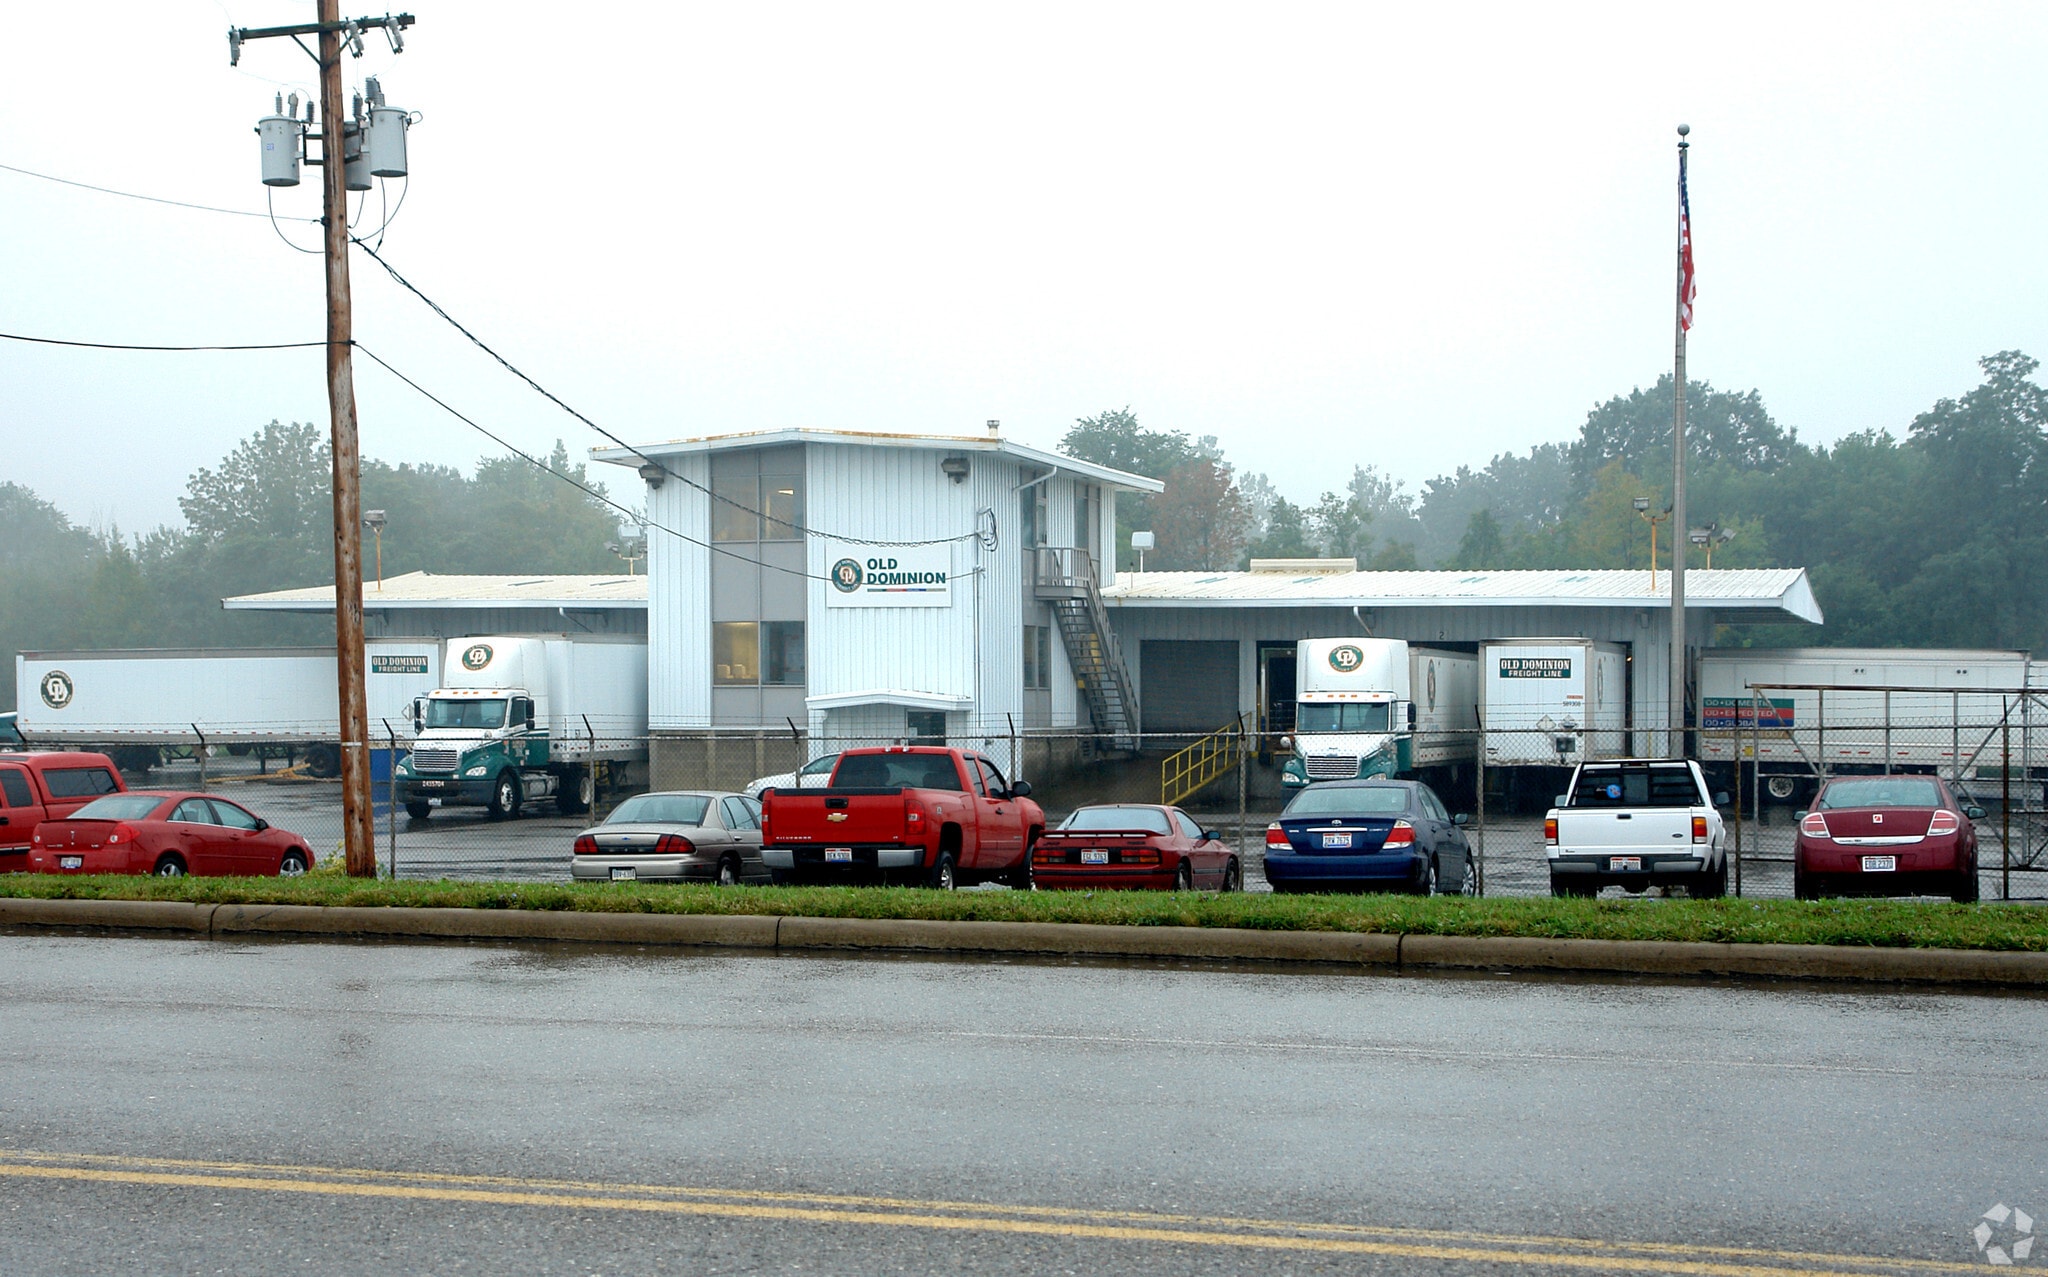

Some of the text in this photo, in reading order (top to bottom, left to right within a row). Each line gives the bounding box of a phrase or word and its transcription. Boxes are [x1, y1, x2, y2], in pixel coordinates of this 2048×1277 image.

[867, 558, 898, 570] OLD
[867, 572, 946, 585] DOMINION
[1439, 631, 1445, 640] 2
[372, 657, 428, 666] OLD DOMINION
[1501, 660, 1570, 670] OLD DOMINION
